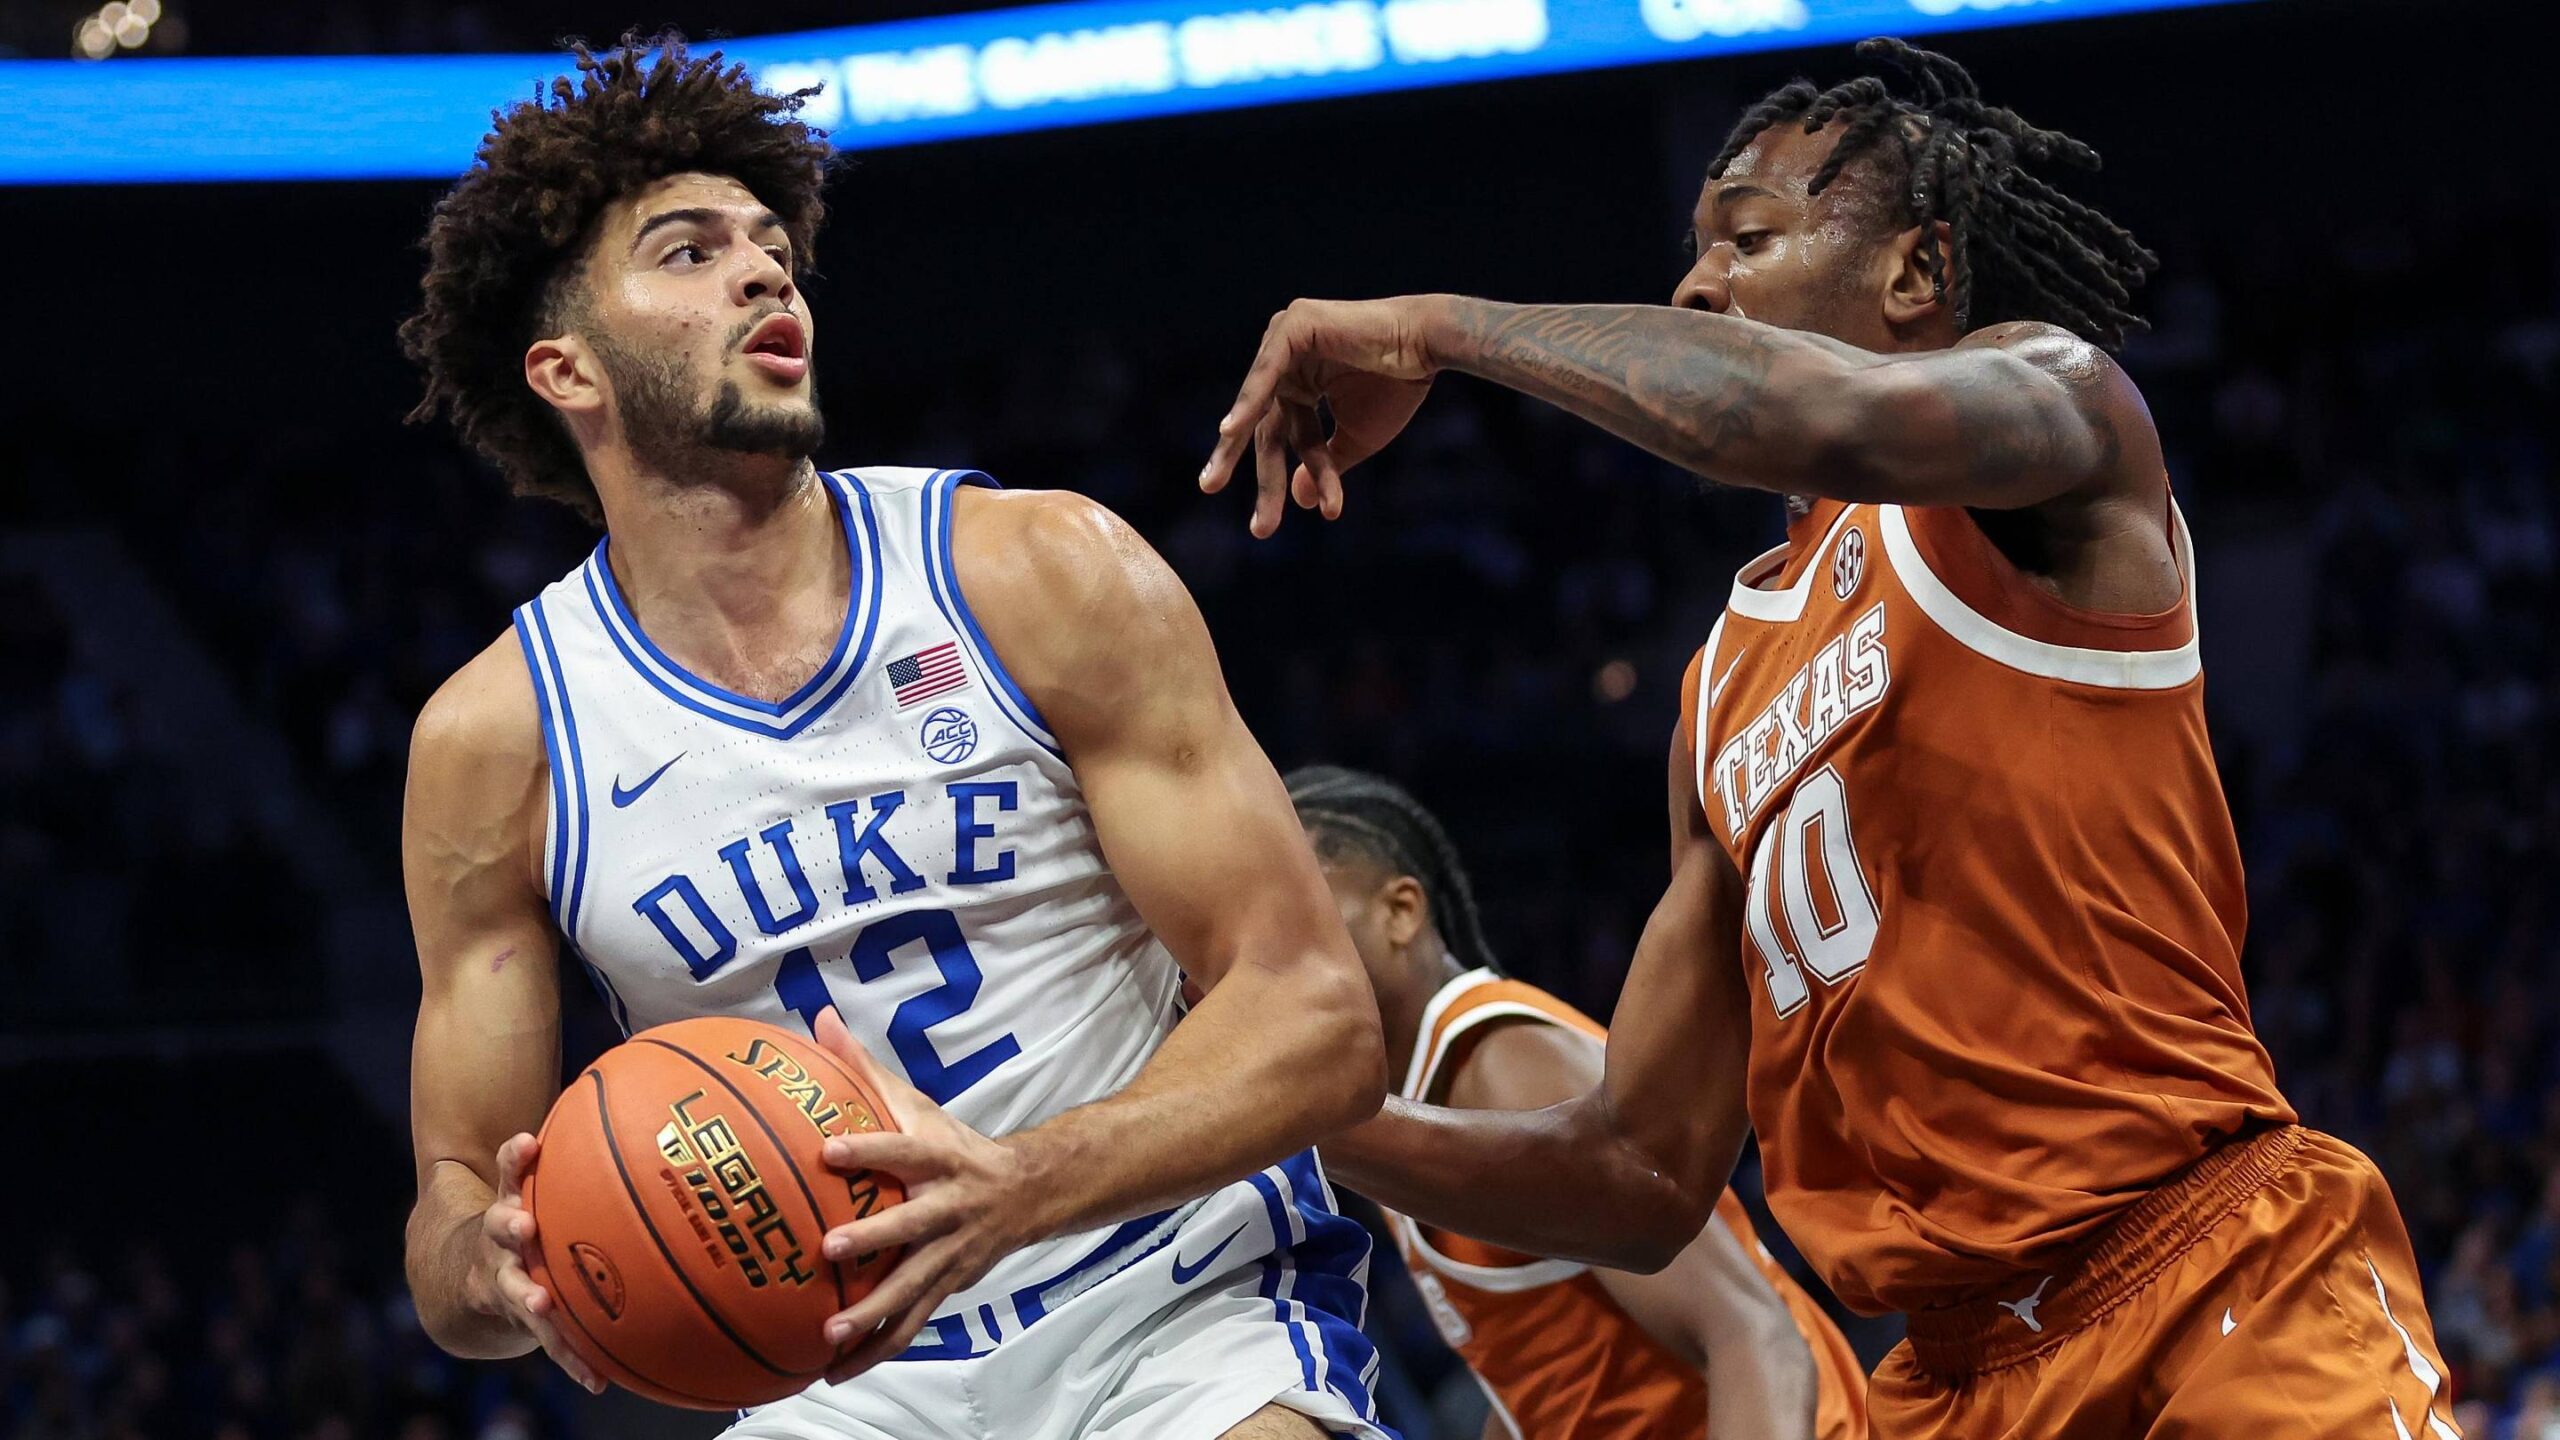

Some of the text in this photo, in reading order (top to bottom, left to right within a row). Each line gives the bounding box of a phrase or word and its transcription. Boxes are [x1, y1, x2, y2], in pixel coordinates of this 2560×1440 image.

[1834, 531, 1862, 597] SEC
[929, 721, 976, 745] ACC
[1713, 600, 1891, 846] TEXAS
[632, 781, 1018, 983] DUKE
[1744, 762, 1882, 1020] 10
[669, 1087, 816, 1287] LEGACY
[682, 1166, 769, 1289] 1000
[726, 1037, 886, 1270] SPALIN
